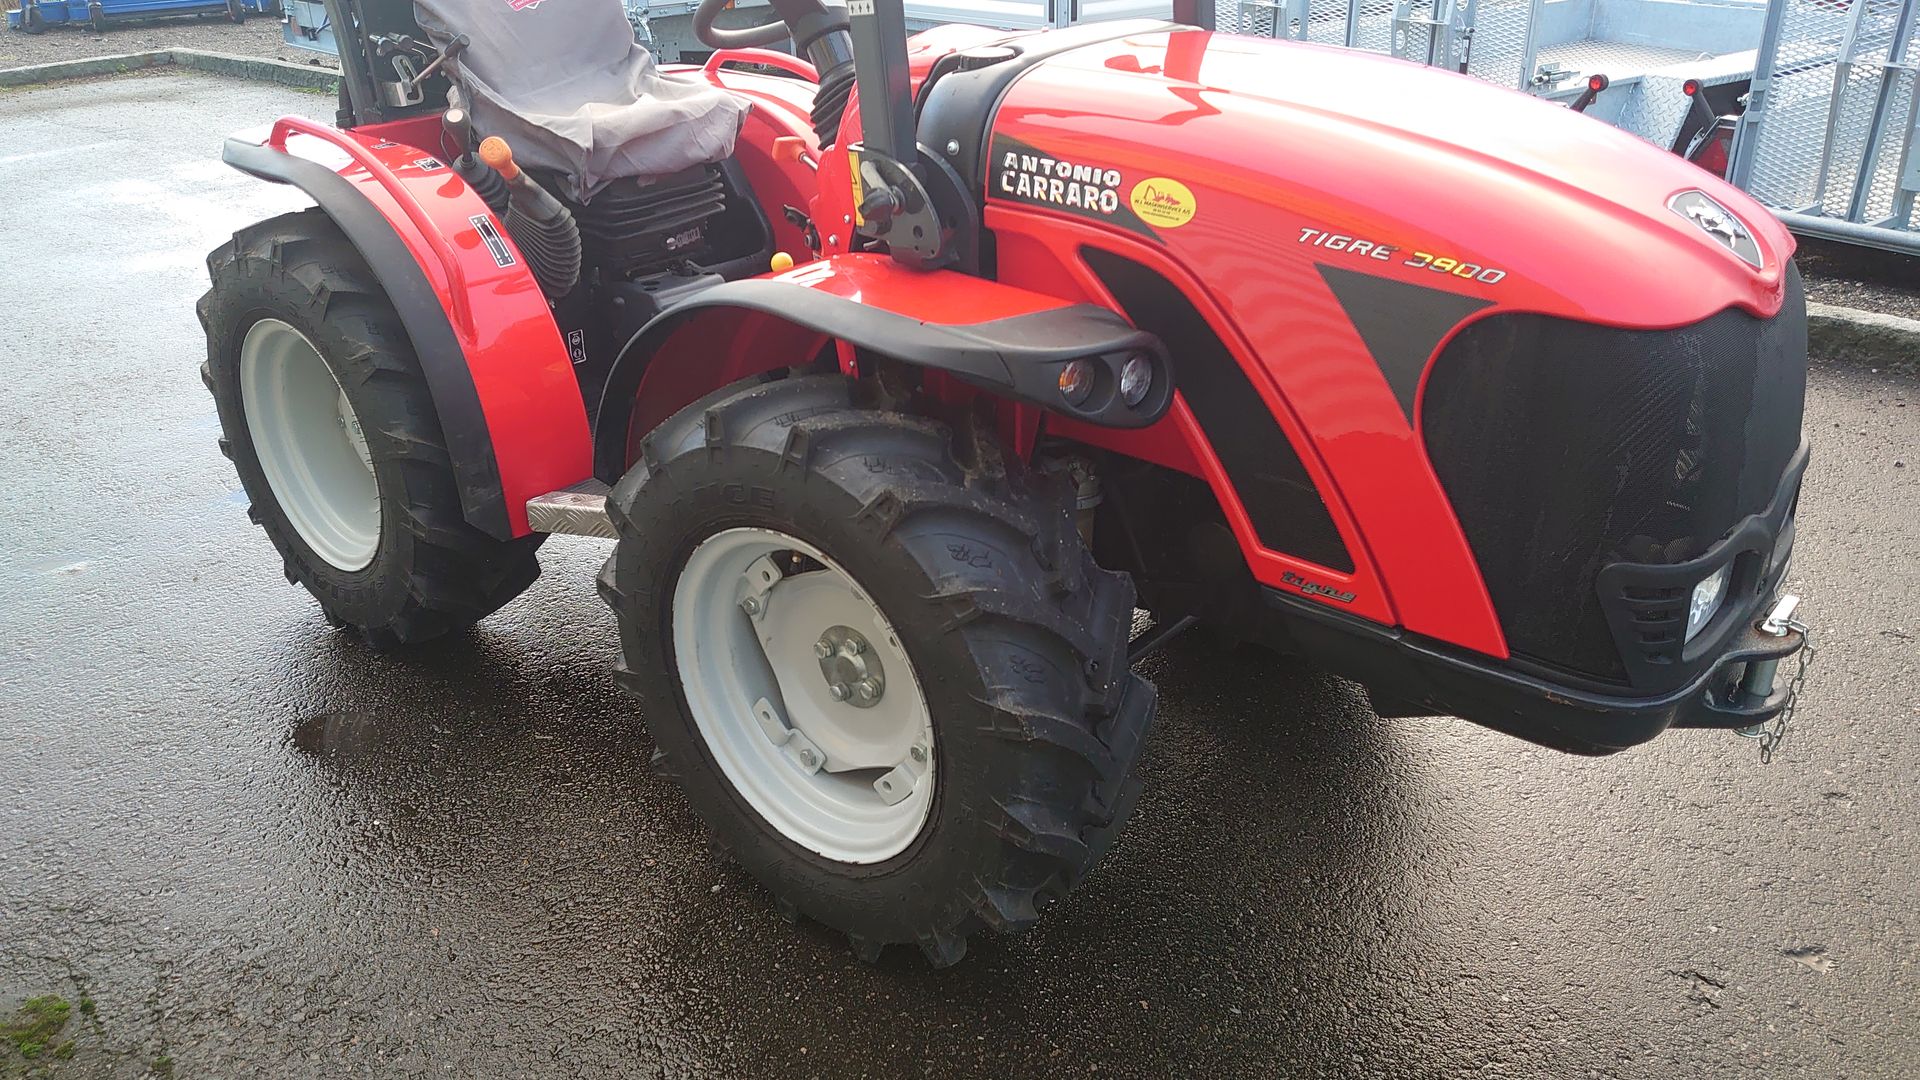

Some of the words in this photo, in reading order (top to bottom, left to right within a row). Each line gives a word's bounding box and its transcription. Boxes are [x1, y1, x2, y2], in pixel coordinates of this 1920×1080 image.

[1003, 152, 1122, 188] ANTONIO
[1001, 170, 1119, 214] CARRARO
[1298, 227, 1397, 262] TIGRE
